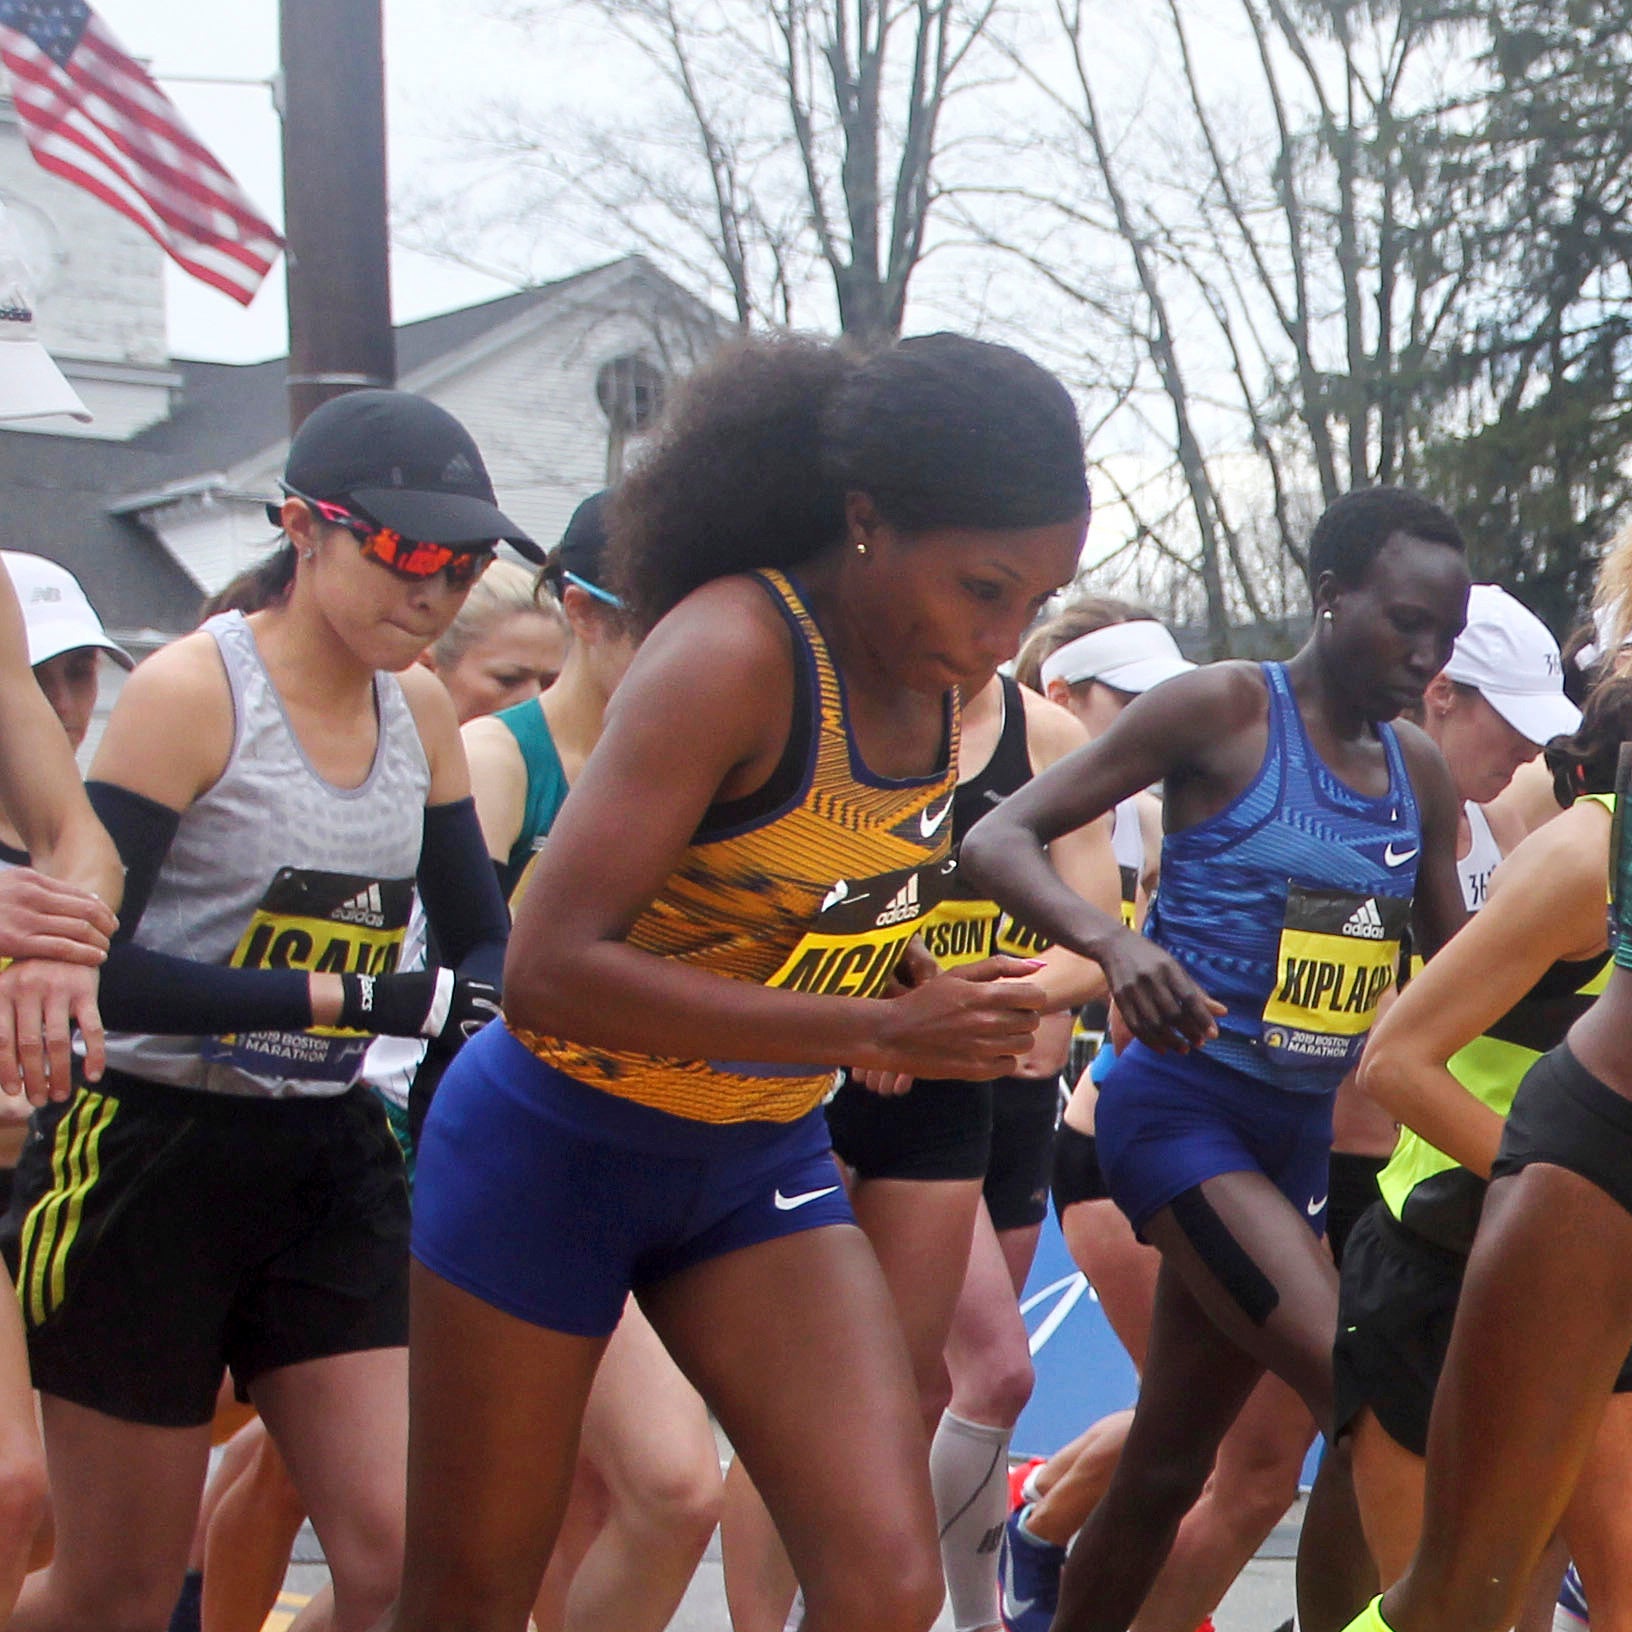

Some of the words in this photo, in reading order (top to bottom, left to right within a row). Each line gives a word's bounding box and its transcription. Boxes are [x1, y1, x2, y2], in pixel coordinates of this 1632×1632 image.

[331, 907, 385, 927] adidas
[875, 903, 921, 927] adidas
[1342, 922, 1385, 939] adidas
[281, 1032, 330, 1051] BOSTON
[1291, 1031, 1315, 1044] 2019
[1315, 1033, 1350, 1047] BOSTON
[245, 1041, 328, 1063] MARATHON
[1287, 1041, 1349, 1058] MARATHON
